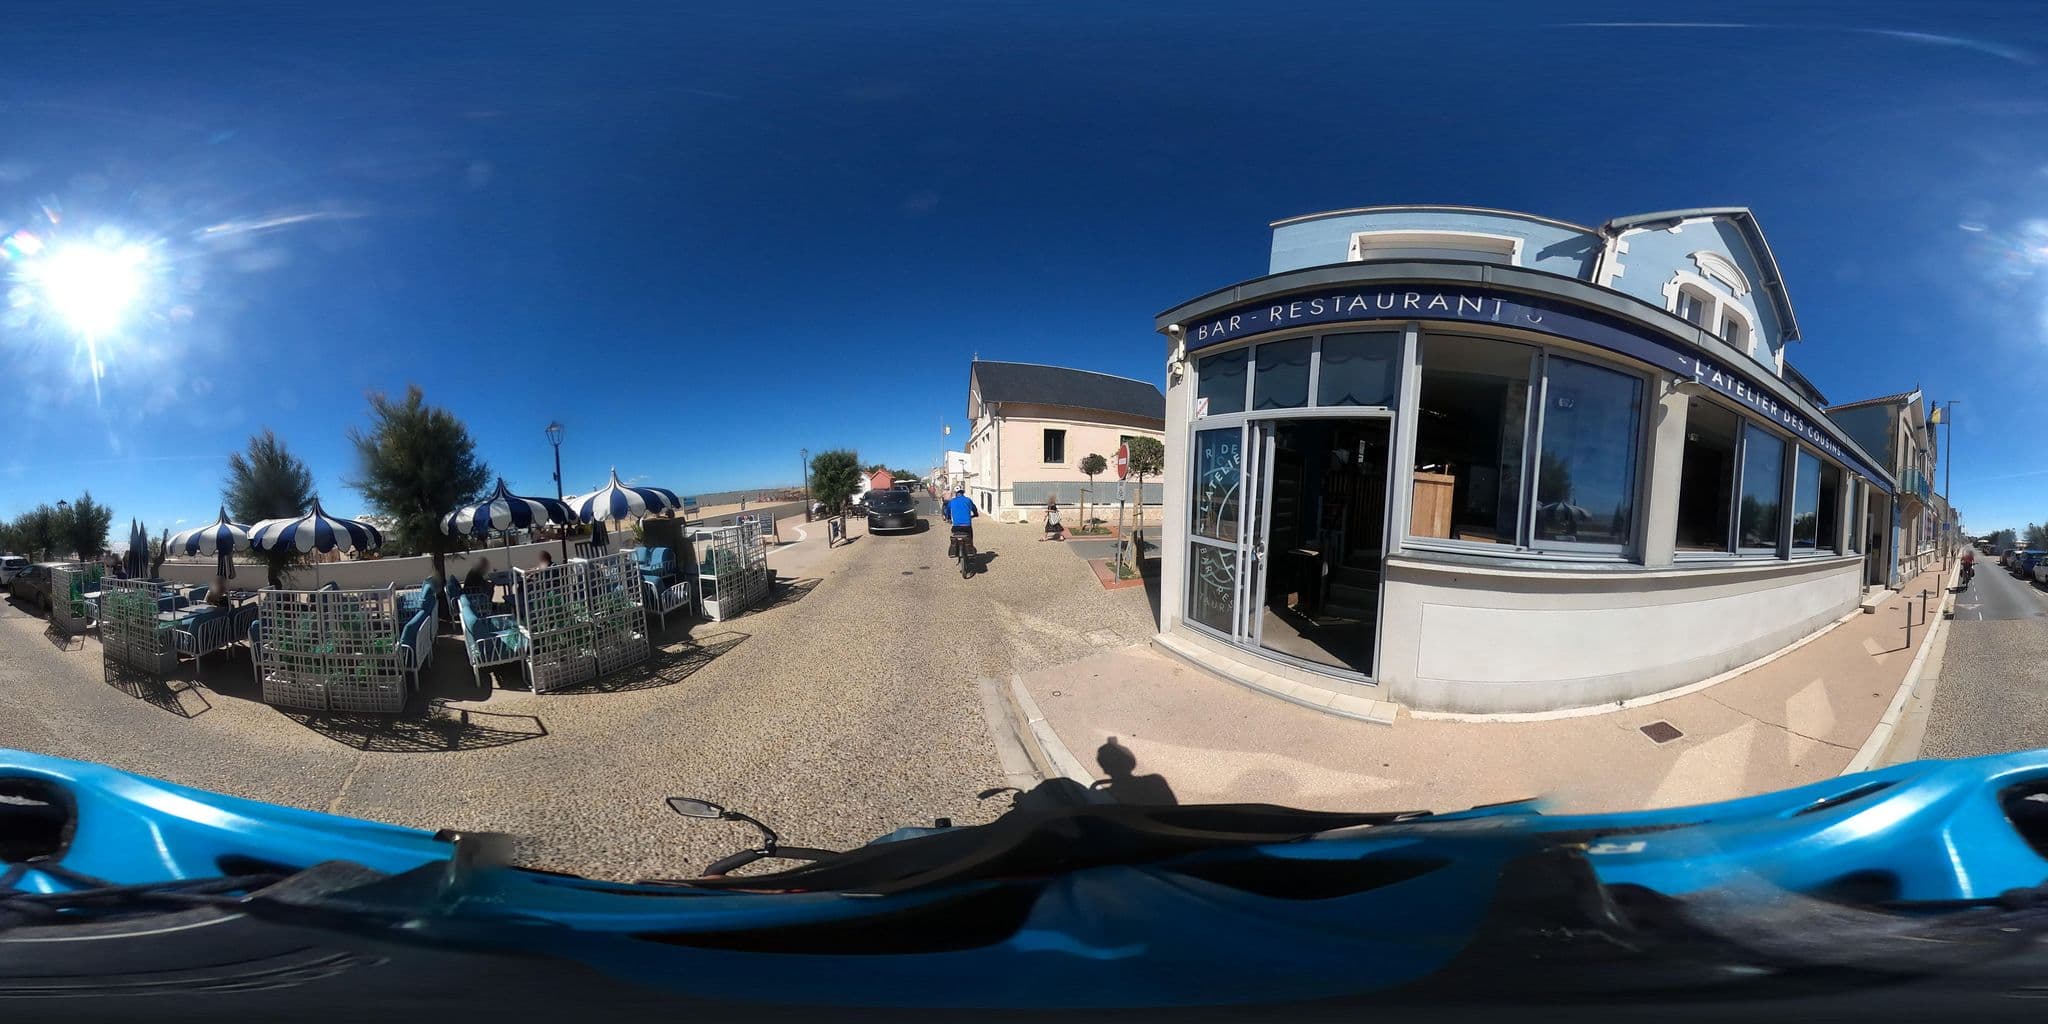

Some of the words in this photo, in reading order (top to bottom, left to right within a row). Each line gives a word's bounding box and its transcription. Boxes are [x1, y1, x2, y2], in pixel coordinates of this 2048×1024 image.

[1198, 315, 1241, 341] BAR
[1269, 292, 1508, 322] RESTAURANT
[1695, 358, 1778, 416] L'ATELIER
[1783, 409, 1804, 432] DES
[1807, 426, 1841, 457] COUSINS
[1200, 453, 1241, 513] L'ATELIE
